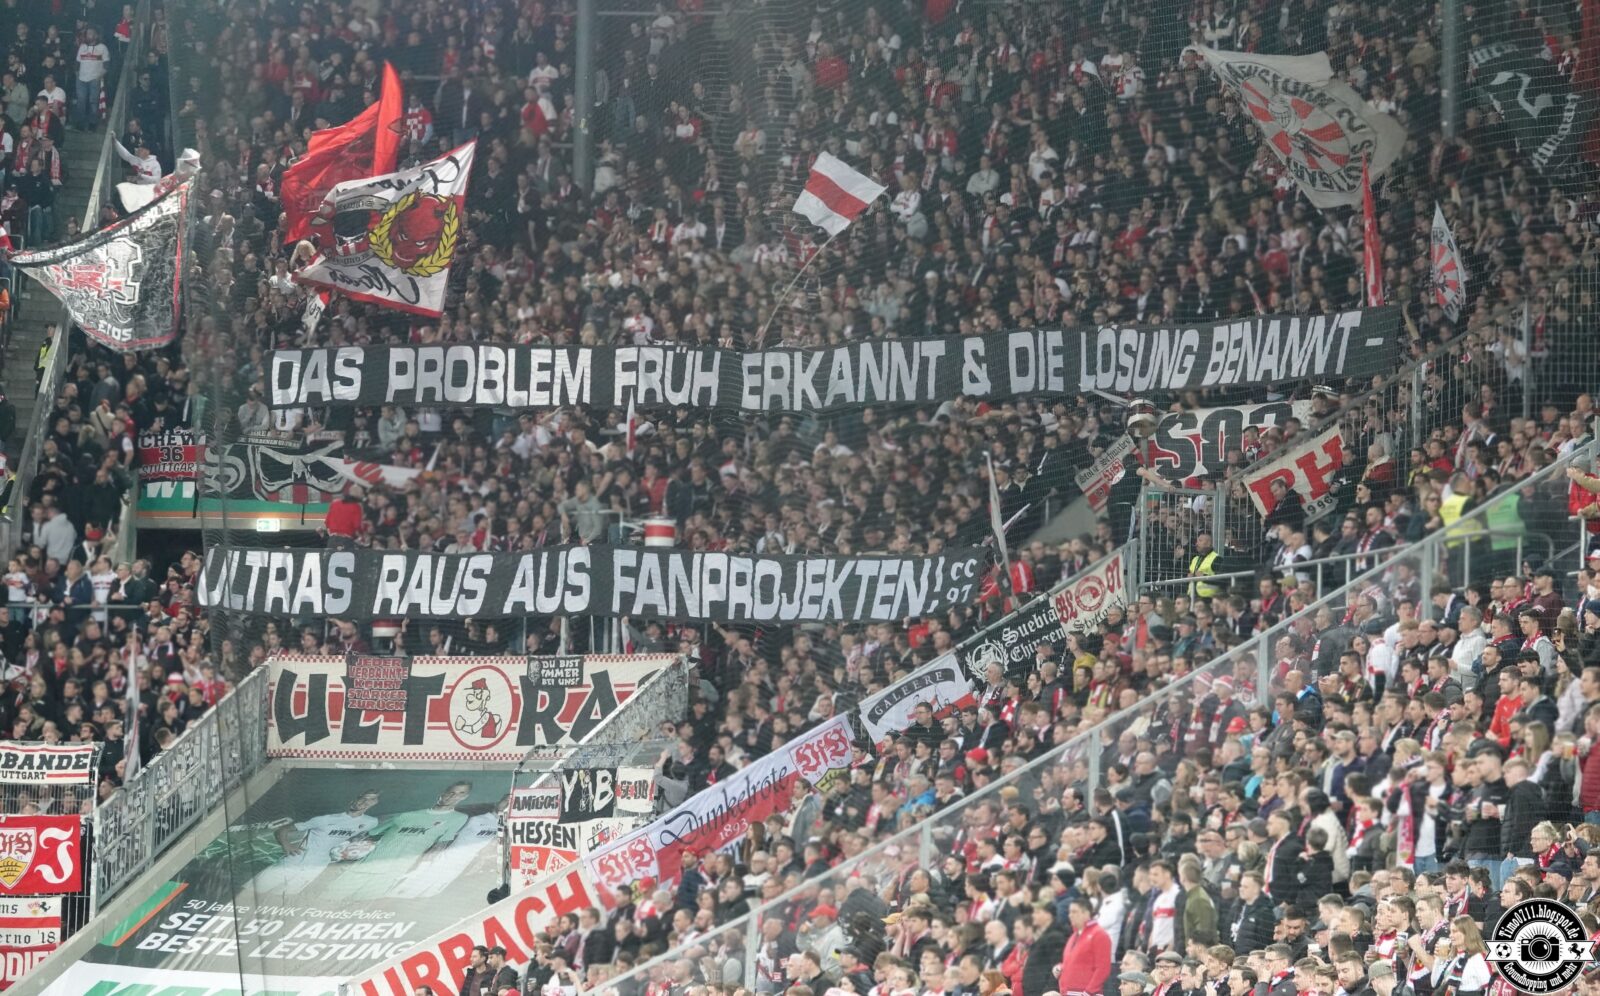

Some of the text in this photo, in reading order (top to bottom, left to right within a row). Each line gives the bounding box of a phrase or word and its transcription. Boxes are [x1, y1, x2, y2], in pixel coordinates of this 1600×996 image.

[271, 346, 364, 405] DAS
[385, 345, 592, 407] PROBLEM
[613, 345, 721, 407] FRÜH
[741, 339, 946, 411] ERKANNT
[962, 336, 992, 396] &
[1008, 330, 1064, 394] DIE
[1080, 324, 1200, 392] LÖSUNG
[1201, 310, 1362, 386] BENANNT
[160, 446, 185, 462] 36
[950, 558, 978, 582] CC
[197, 546, 945, 620] ULTRAS RAUS AUS FANPROJEKTEN!
[946, 584, 974, 605] 97
[1002, 606, 1058, 648] Suebia
[349, 666, 409, 679] VERBANNTE
[355, 657, 403, 667] JEDER
[541, 668, 580, 678] IMMER
[542, 659, 581, 669] DU BIST
[354, 678, 403, 689] KEHRT
[541, 677, 580, 686] BEI UNS!
[873, 671, 945, 716] GALEERE
[0, 751, 89, 771] BANDE
[561, 770, 578, 813] Y
[593, 769, 614, 813] B
[659, 765, 788, 848] Dunkelrote
[512, 821, 577, 850] HESSEN
[719, 817, 749, 841] 1893
[184, 898, 207, 910] 50
[205, 901, 250, 914] Jahre
[300, 907, 396, 920] FondsPolice
[159, 912, 416, 942] SEIT 50 JAHREN
[360, 869, 595, 996] URBACH
[136, 932, 418, 961] BESTE LEISTUNG
